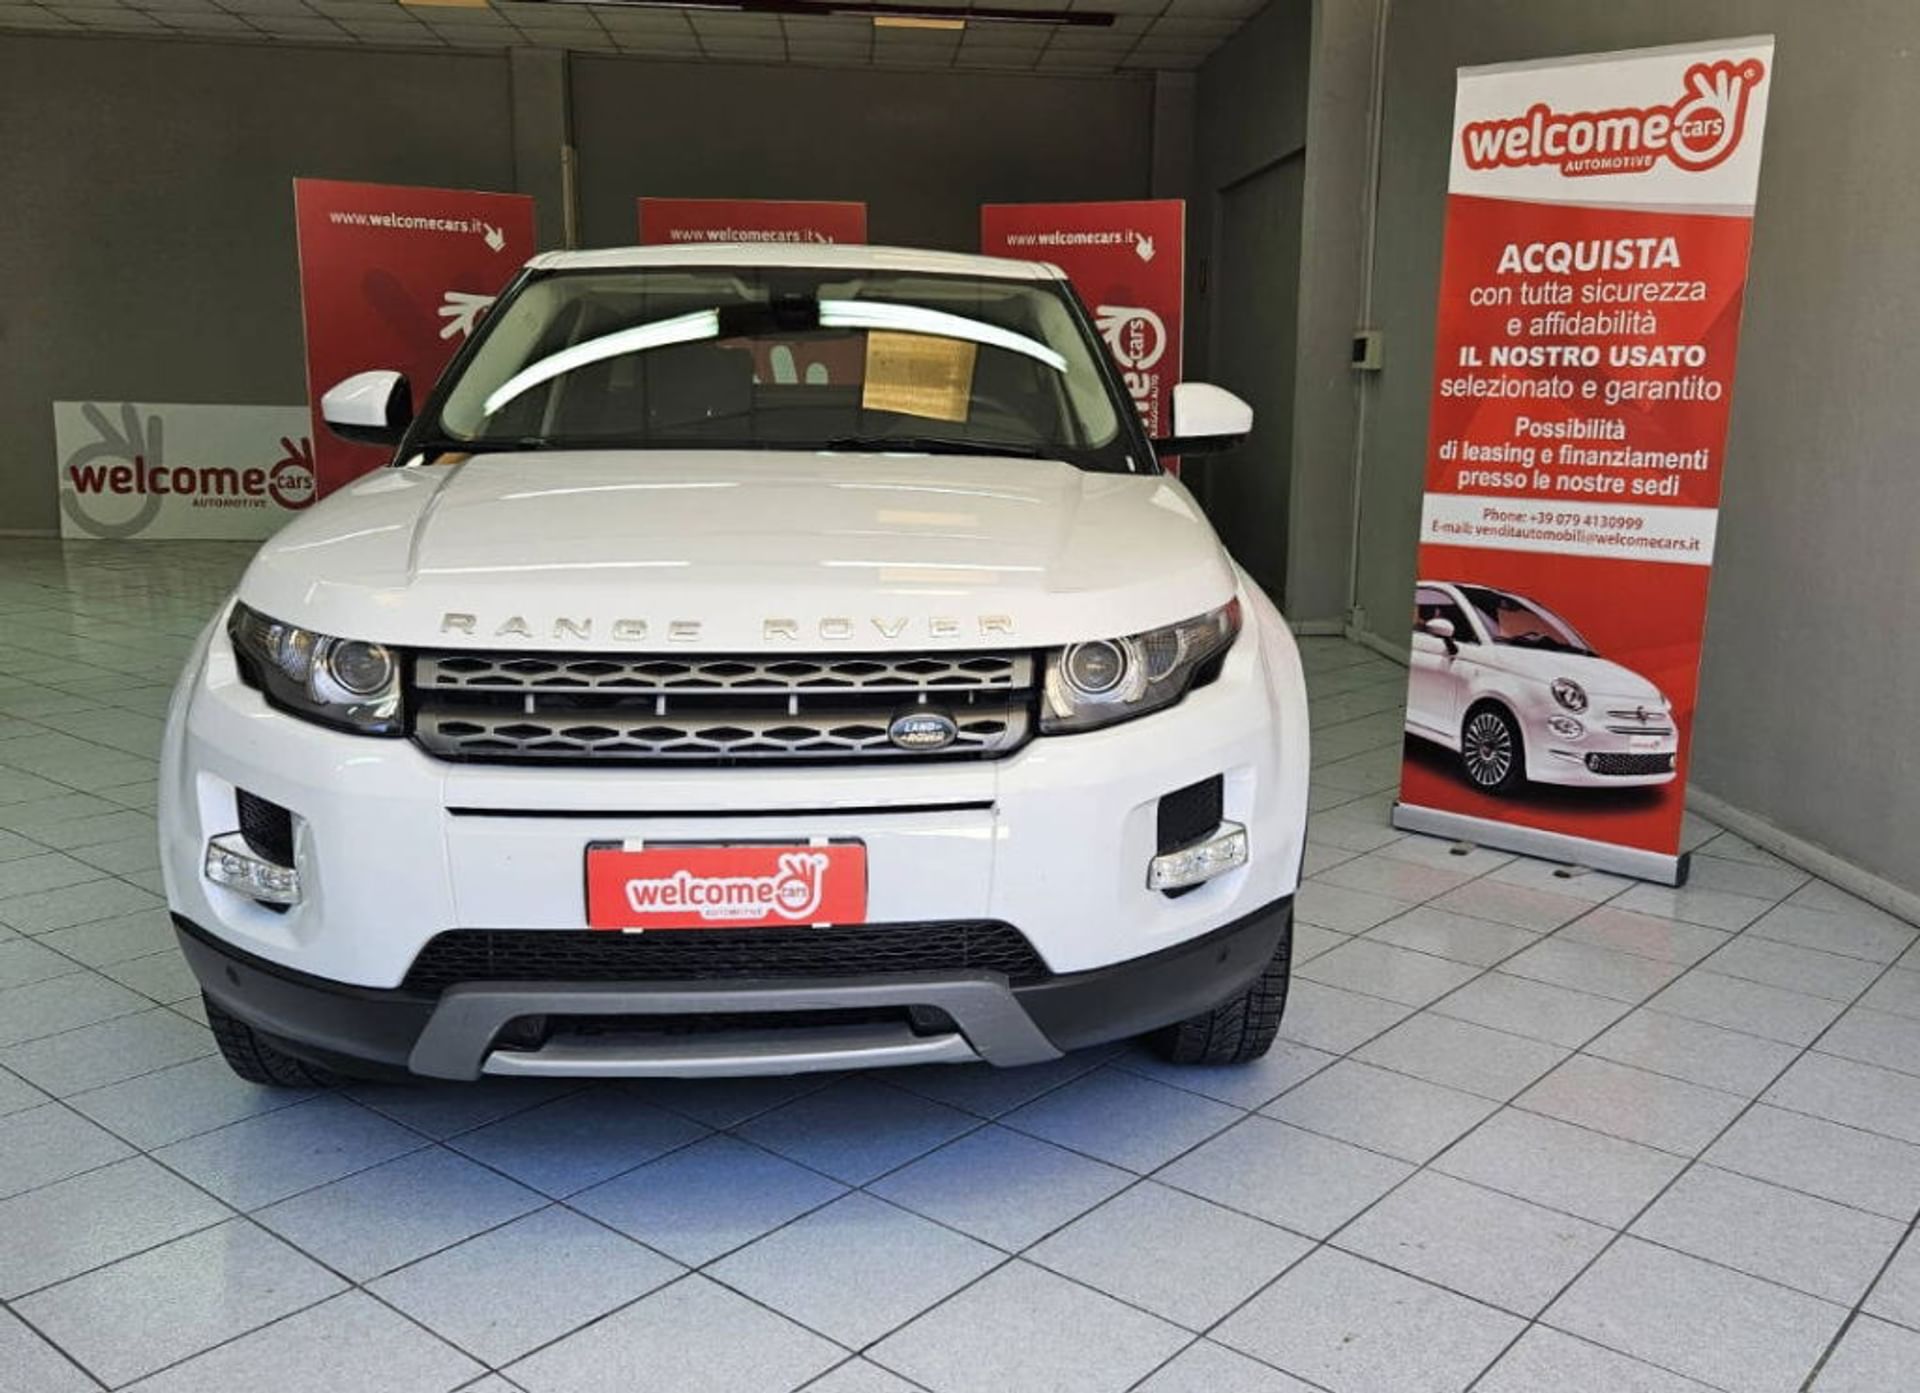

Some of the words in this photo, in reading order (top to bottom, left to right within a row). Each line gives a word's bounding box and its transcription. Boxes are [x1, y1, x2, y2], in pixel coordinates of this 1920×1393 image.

[1468, 112, 1669, 162] welcome
[1680, 117, 1723, 138] cars
[1565, 155, 1653, 172] AUTOMOTIVE
[330, 212, 481, 232] www.welcomecars.it
[1007, 229, 1134, 246] www.welcomecars.it
[1497, 237, 1681, 275] ACQUISTA
[1469, 284, 1511, 305] con
[1521, 281, 1573, 305] tutta
[1581, 278, 1706, 304] sicurezza
[1507, 319, 1522, 336] e
[1530, 310, 1657, 336] affidabilità
[1130, 319, 1144, 361] cars
[1459, 346, 1482, 367] IL
[1490, 345, 1600, 367] NOSTRO
[1610, 345, 1706, 367] USATO
[1440, 374, 1573, 399] selezionato
[1582, 380, 1598, 398] e
[1605, 376, 1722, 405] garantito
[1515, 416, 1626, 440] Possibilità
[1439, 441, 1457, 460] di
[1463, 442, 1533, 467] leasing
[1540, 448, 1553, 464] e
[1559, 445, 1709, 471] finanziamenti
[70, 456, 266, 495] welcome
[277, 474, 312, 490] cars
[1458, 470, 1527, 491] presso
[1533, 470, 1549, 489] le
[1556, 475, 1625, 493] nostre
[1631, 475, 1680, 496] sedi
[192, 497, 267, 508] AUTOMOTIVE
[1432, 519, 1473, 534] E-mail:
[1483, 507, 1528, 521] Phone:
[1530, 511, 1554, 525] +39
[1556, 513, 1581, 526] 079
[1583, 514, 1644, 530] 4130999
[439, 612, 702, 641] RANGE
[763, 614, 1017, 641] ROVER
[632, 877, 773, 905] welcome
[781, 886, 807, 898] cars
